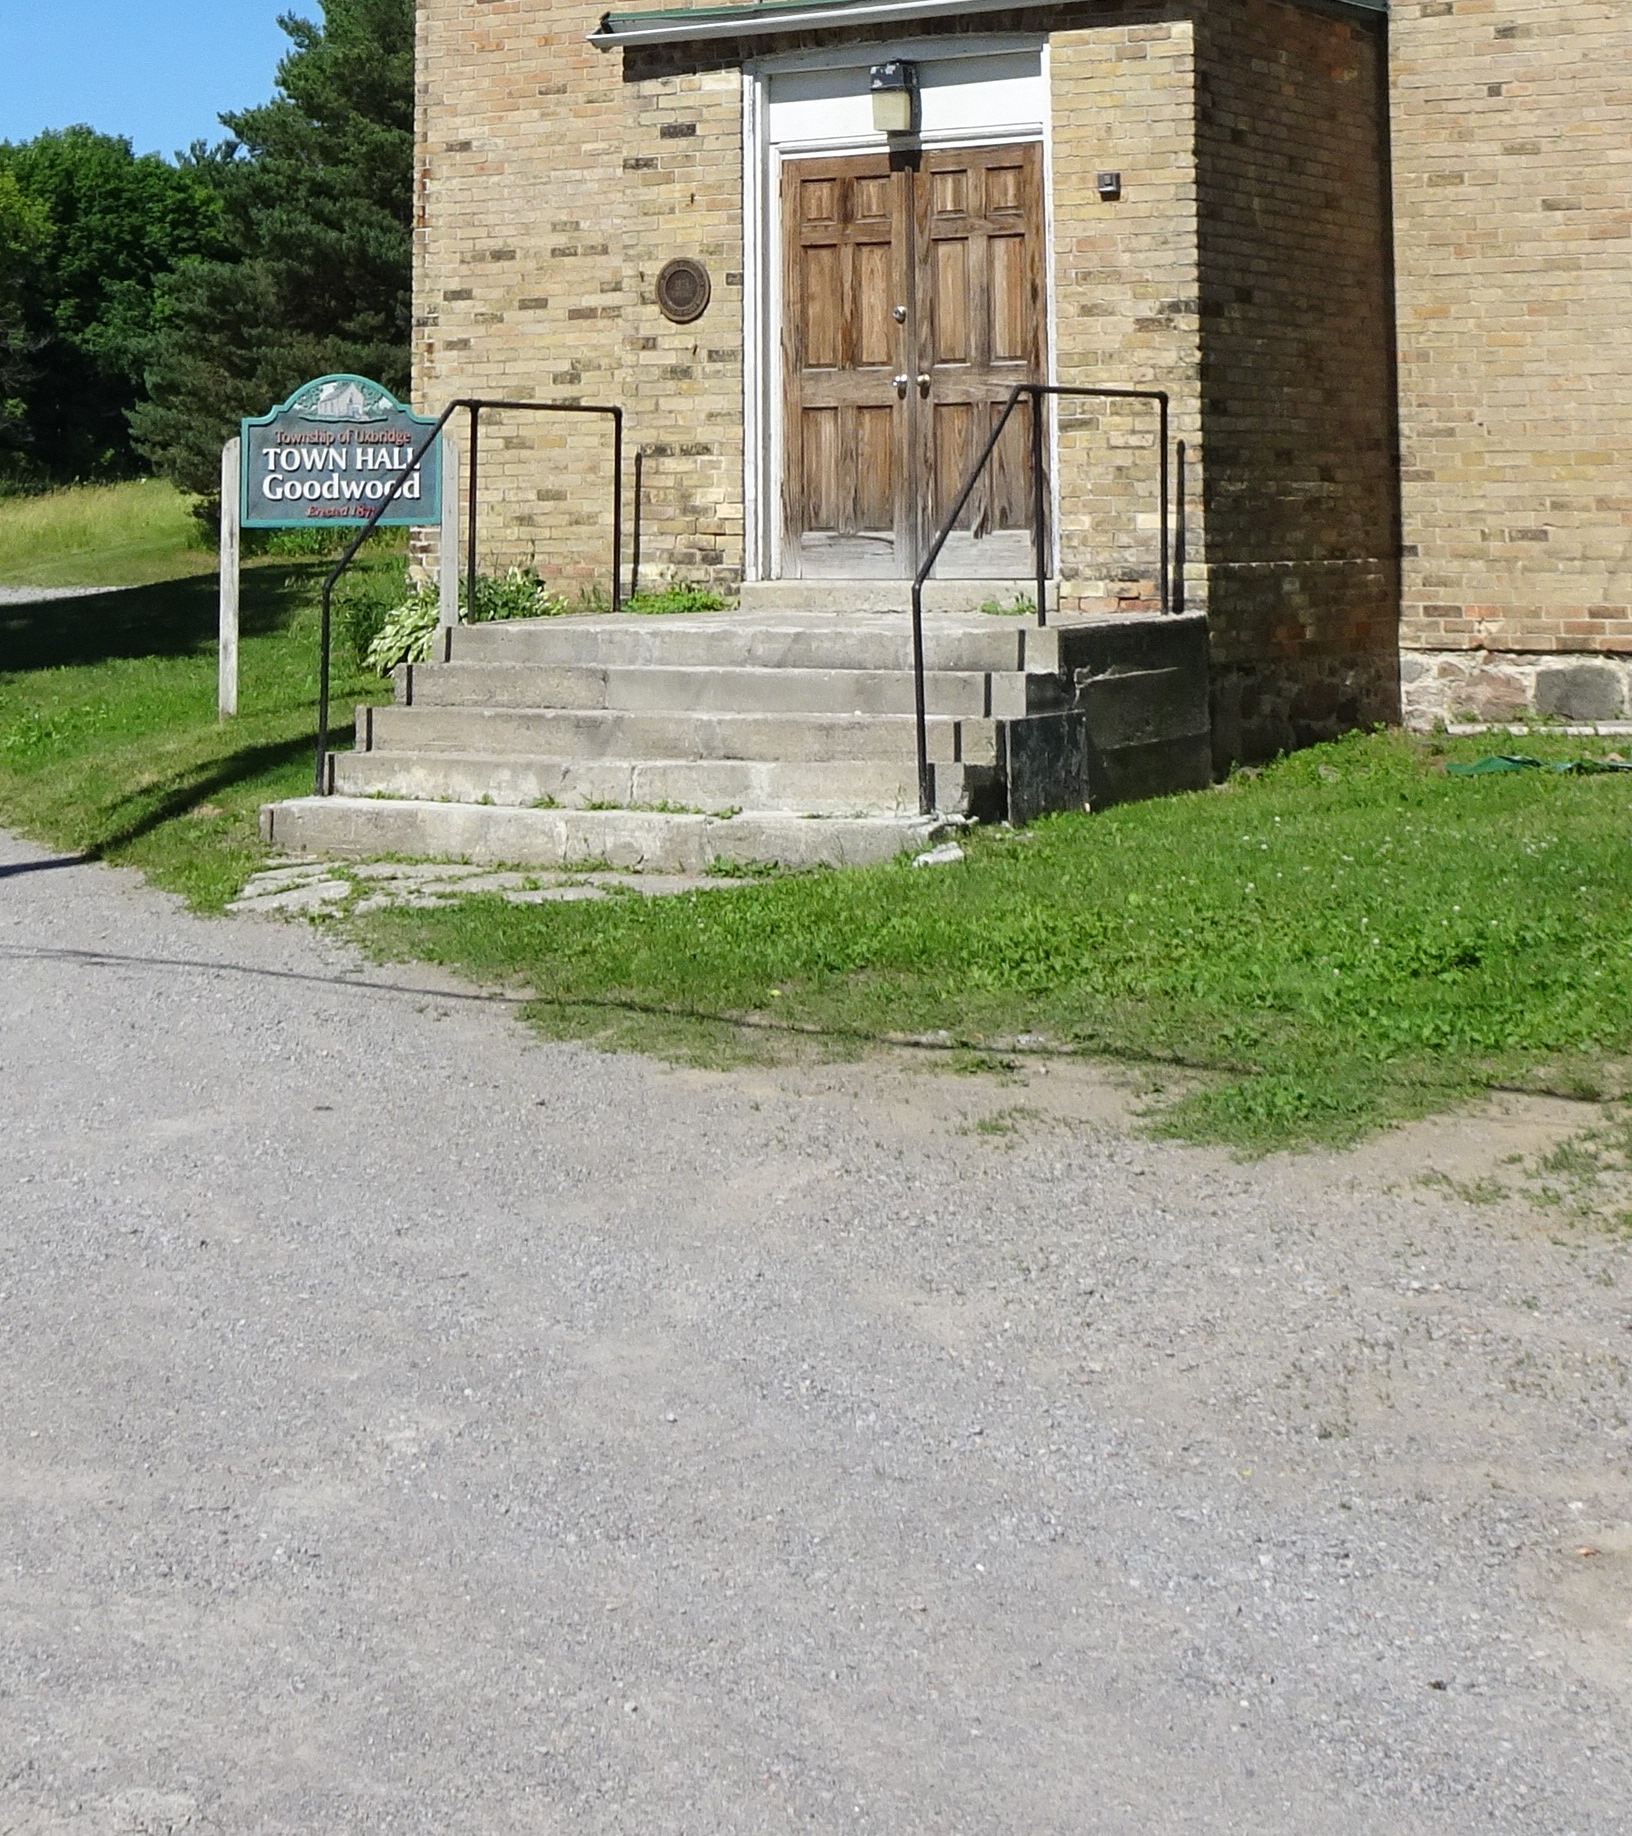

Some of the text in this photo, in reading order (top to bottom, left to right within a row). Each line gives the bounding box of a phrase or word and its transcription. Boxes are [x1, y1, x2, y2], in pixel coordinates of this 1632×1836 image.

[276, 429, 411, 446] Township of Uxbridge
[262, 447, 420, 471] TOWN HALL
[262, 473, 420, 499] Goodwood
